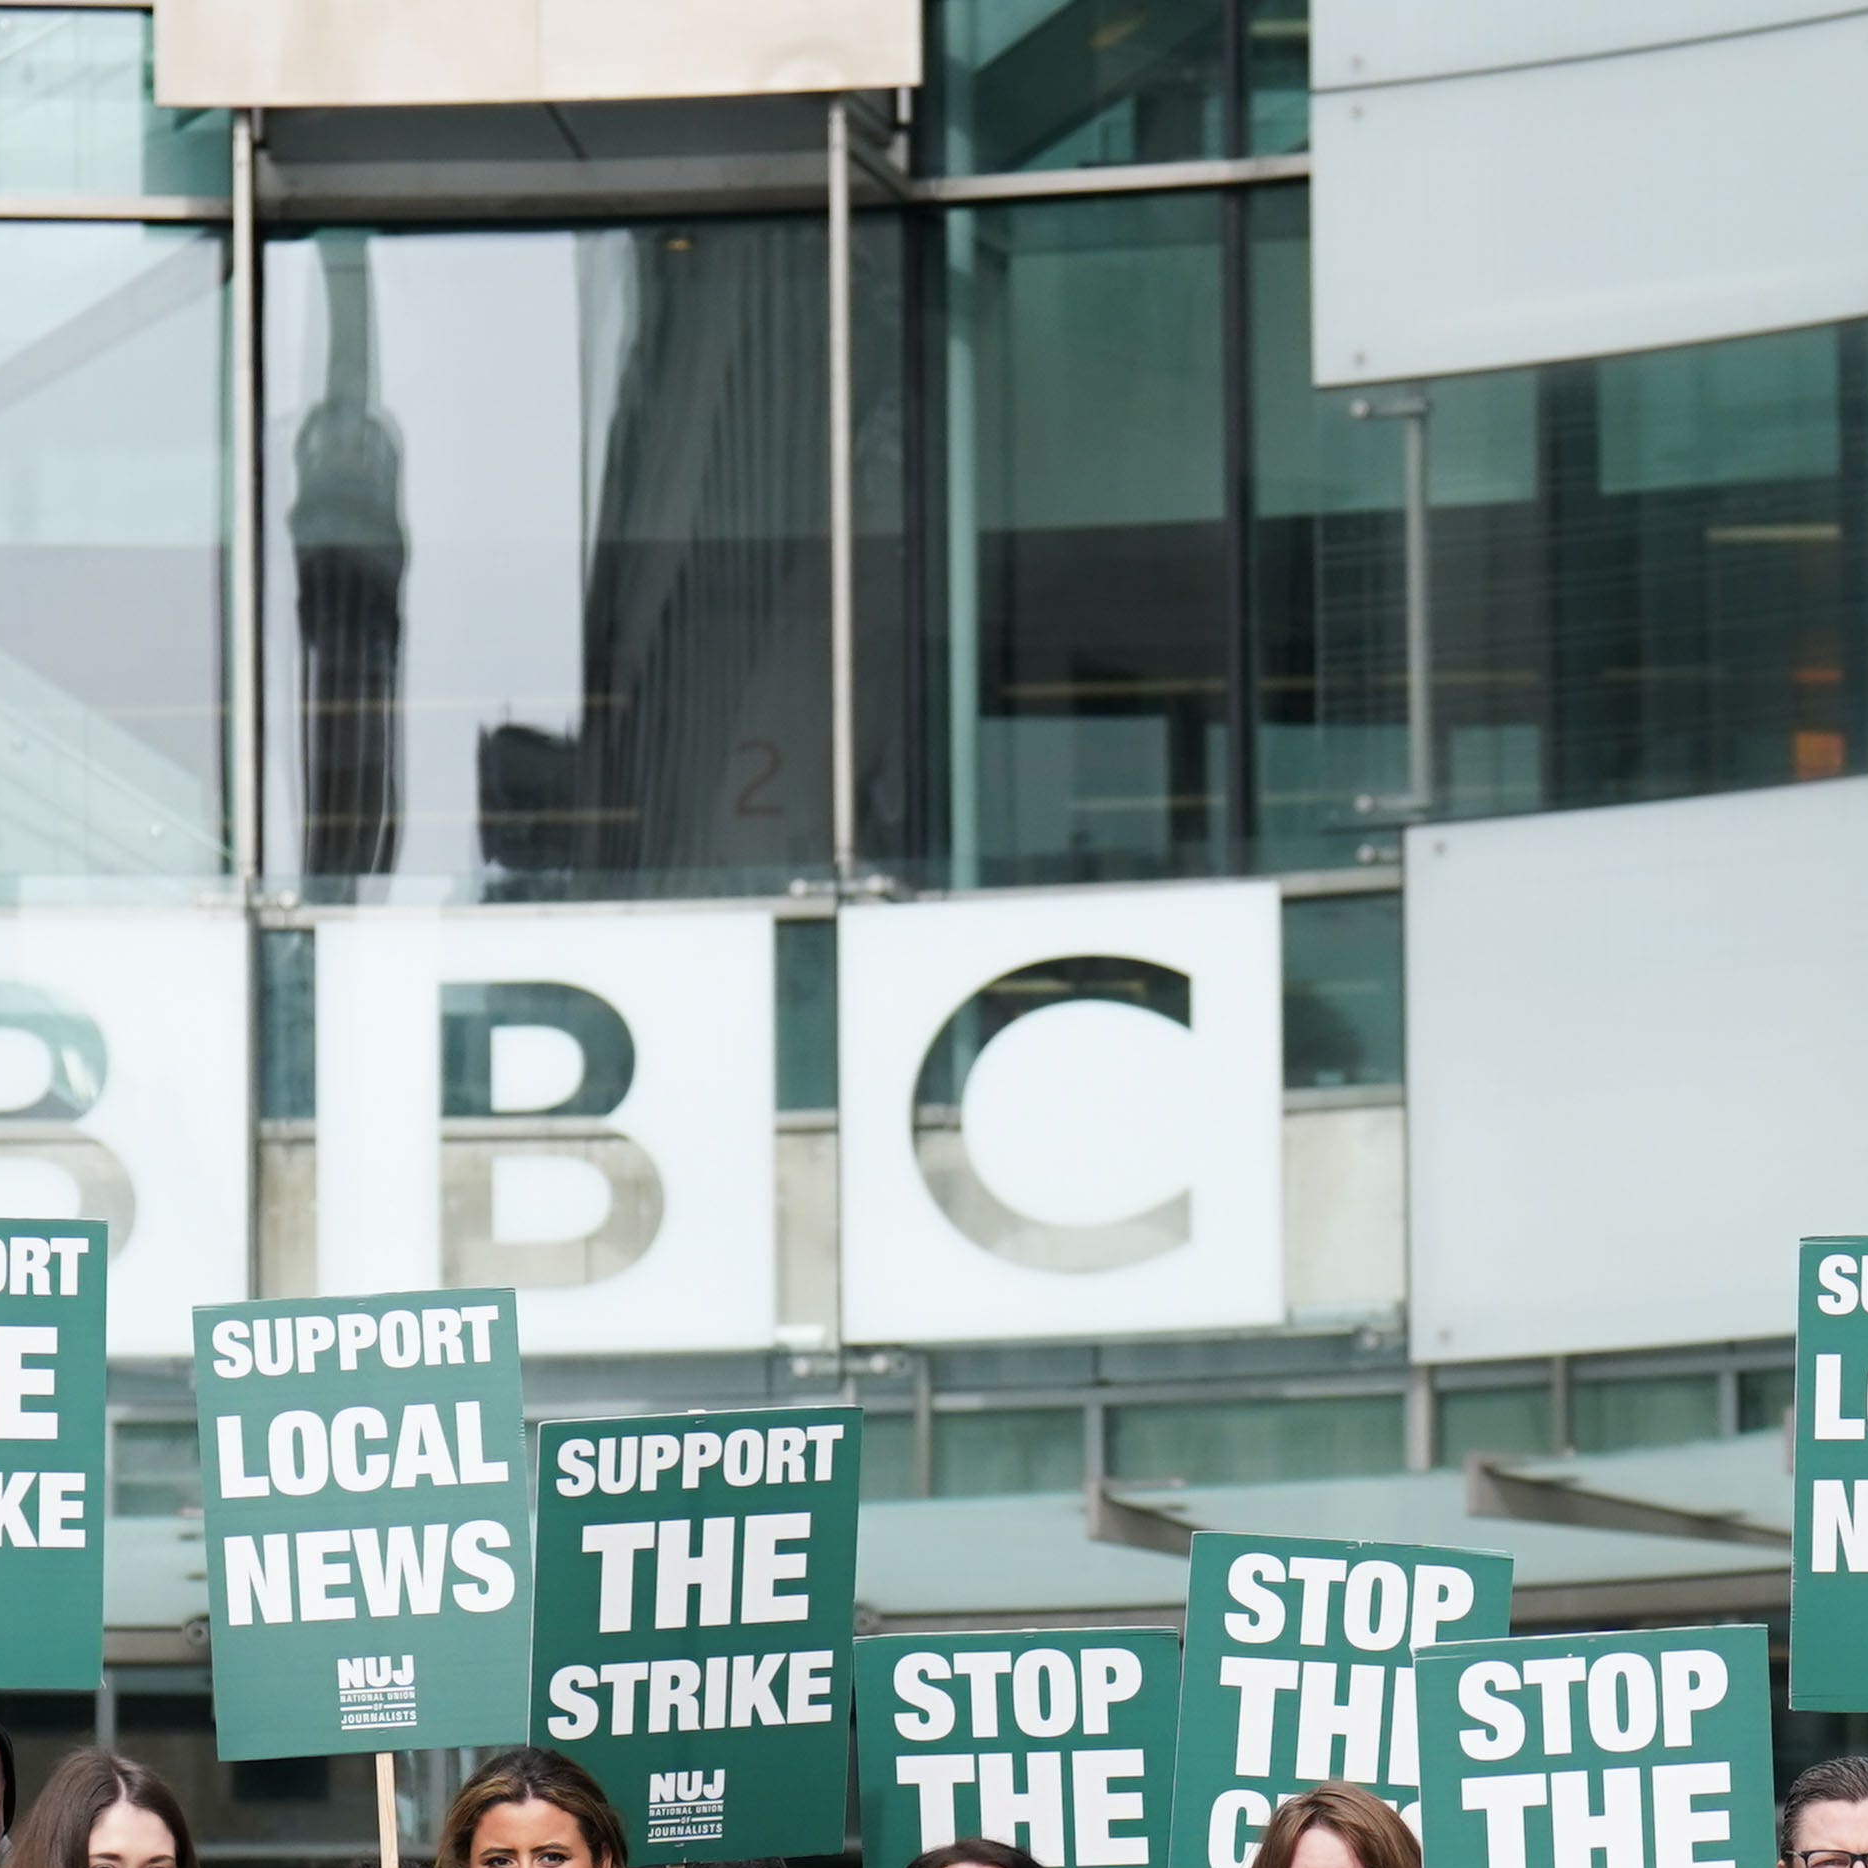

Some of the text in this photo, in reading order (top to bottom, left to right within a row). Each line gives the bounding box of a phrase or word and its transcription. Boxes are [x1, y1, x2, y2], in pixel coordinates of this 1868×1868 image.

[211, 1304, 500, 1379] SUPPORT
[217, 1401, 508, 1498] LOCAL
[555, 1424, 844, 1496] SUPPORT
[224, 1520, 515, 1625] NEWS
[583, 1513, 810, 1632] THE
[1224, 1552, 1475, 1651] STOP
[338, 1655, 414, 1688] NUJ
[340, 1691, 415, 1702] NATIONAL UNION
[548, 1650, 833, 1740] STRIKE
[894, 1649, 1142, 1740] STOP
[1459, 1650, 1729, 1761] STOP
[341, 1711, 416, 1724] JOURNALISTS
[649, 1769, 725, 1803] NUJ
[649, 1804, 724, 1817] NATIONAL UNION
[896, 1749, 1149, 1867] THE
[648, 1824, 722, 1837] JOURNALISTS
